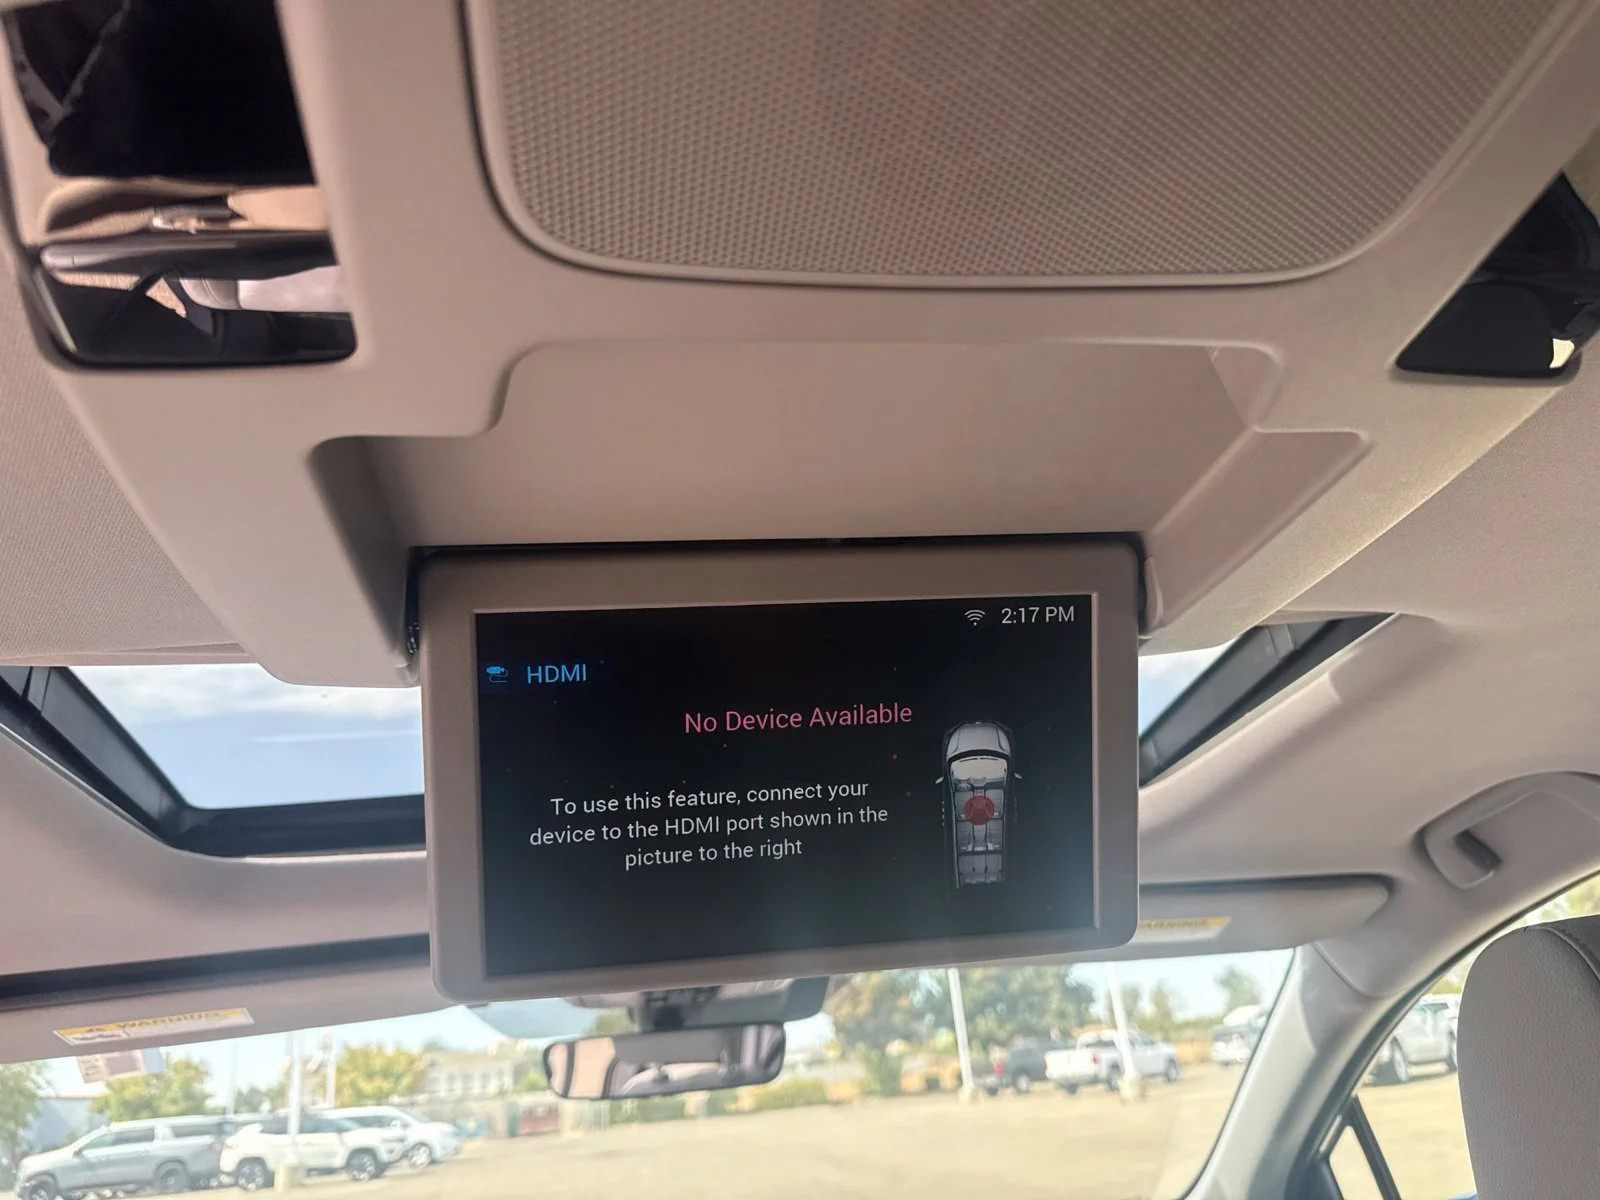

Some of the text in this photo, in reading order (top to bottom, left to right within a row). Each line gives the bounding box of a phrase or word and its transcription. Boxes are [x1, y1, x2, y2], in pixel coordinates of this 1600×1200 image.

[1001, 605, 1075, 624] 2:17 PM
[526, 663, 587, 684] HDMI
[685, 702, 912, 734] No Device Available
[549, 783, 869, 816] To use this feature, connect your
[529, 805, 888, 846] device to the HDMI port shown in the
[625, 838, 802, 871] picture to the right
[1138, 917, 1209, 930] ARNING
[115, 1010, 221, 1029] WARNING
